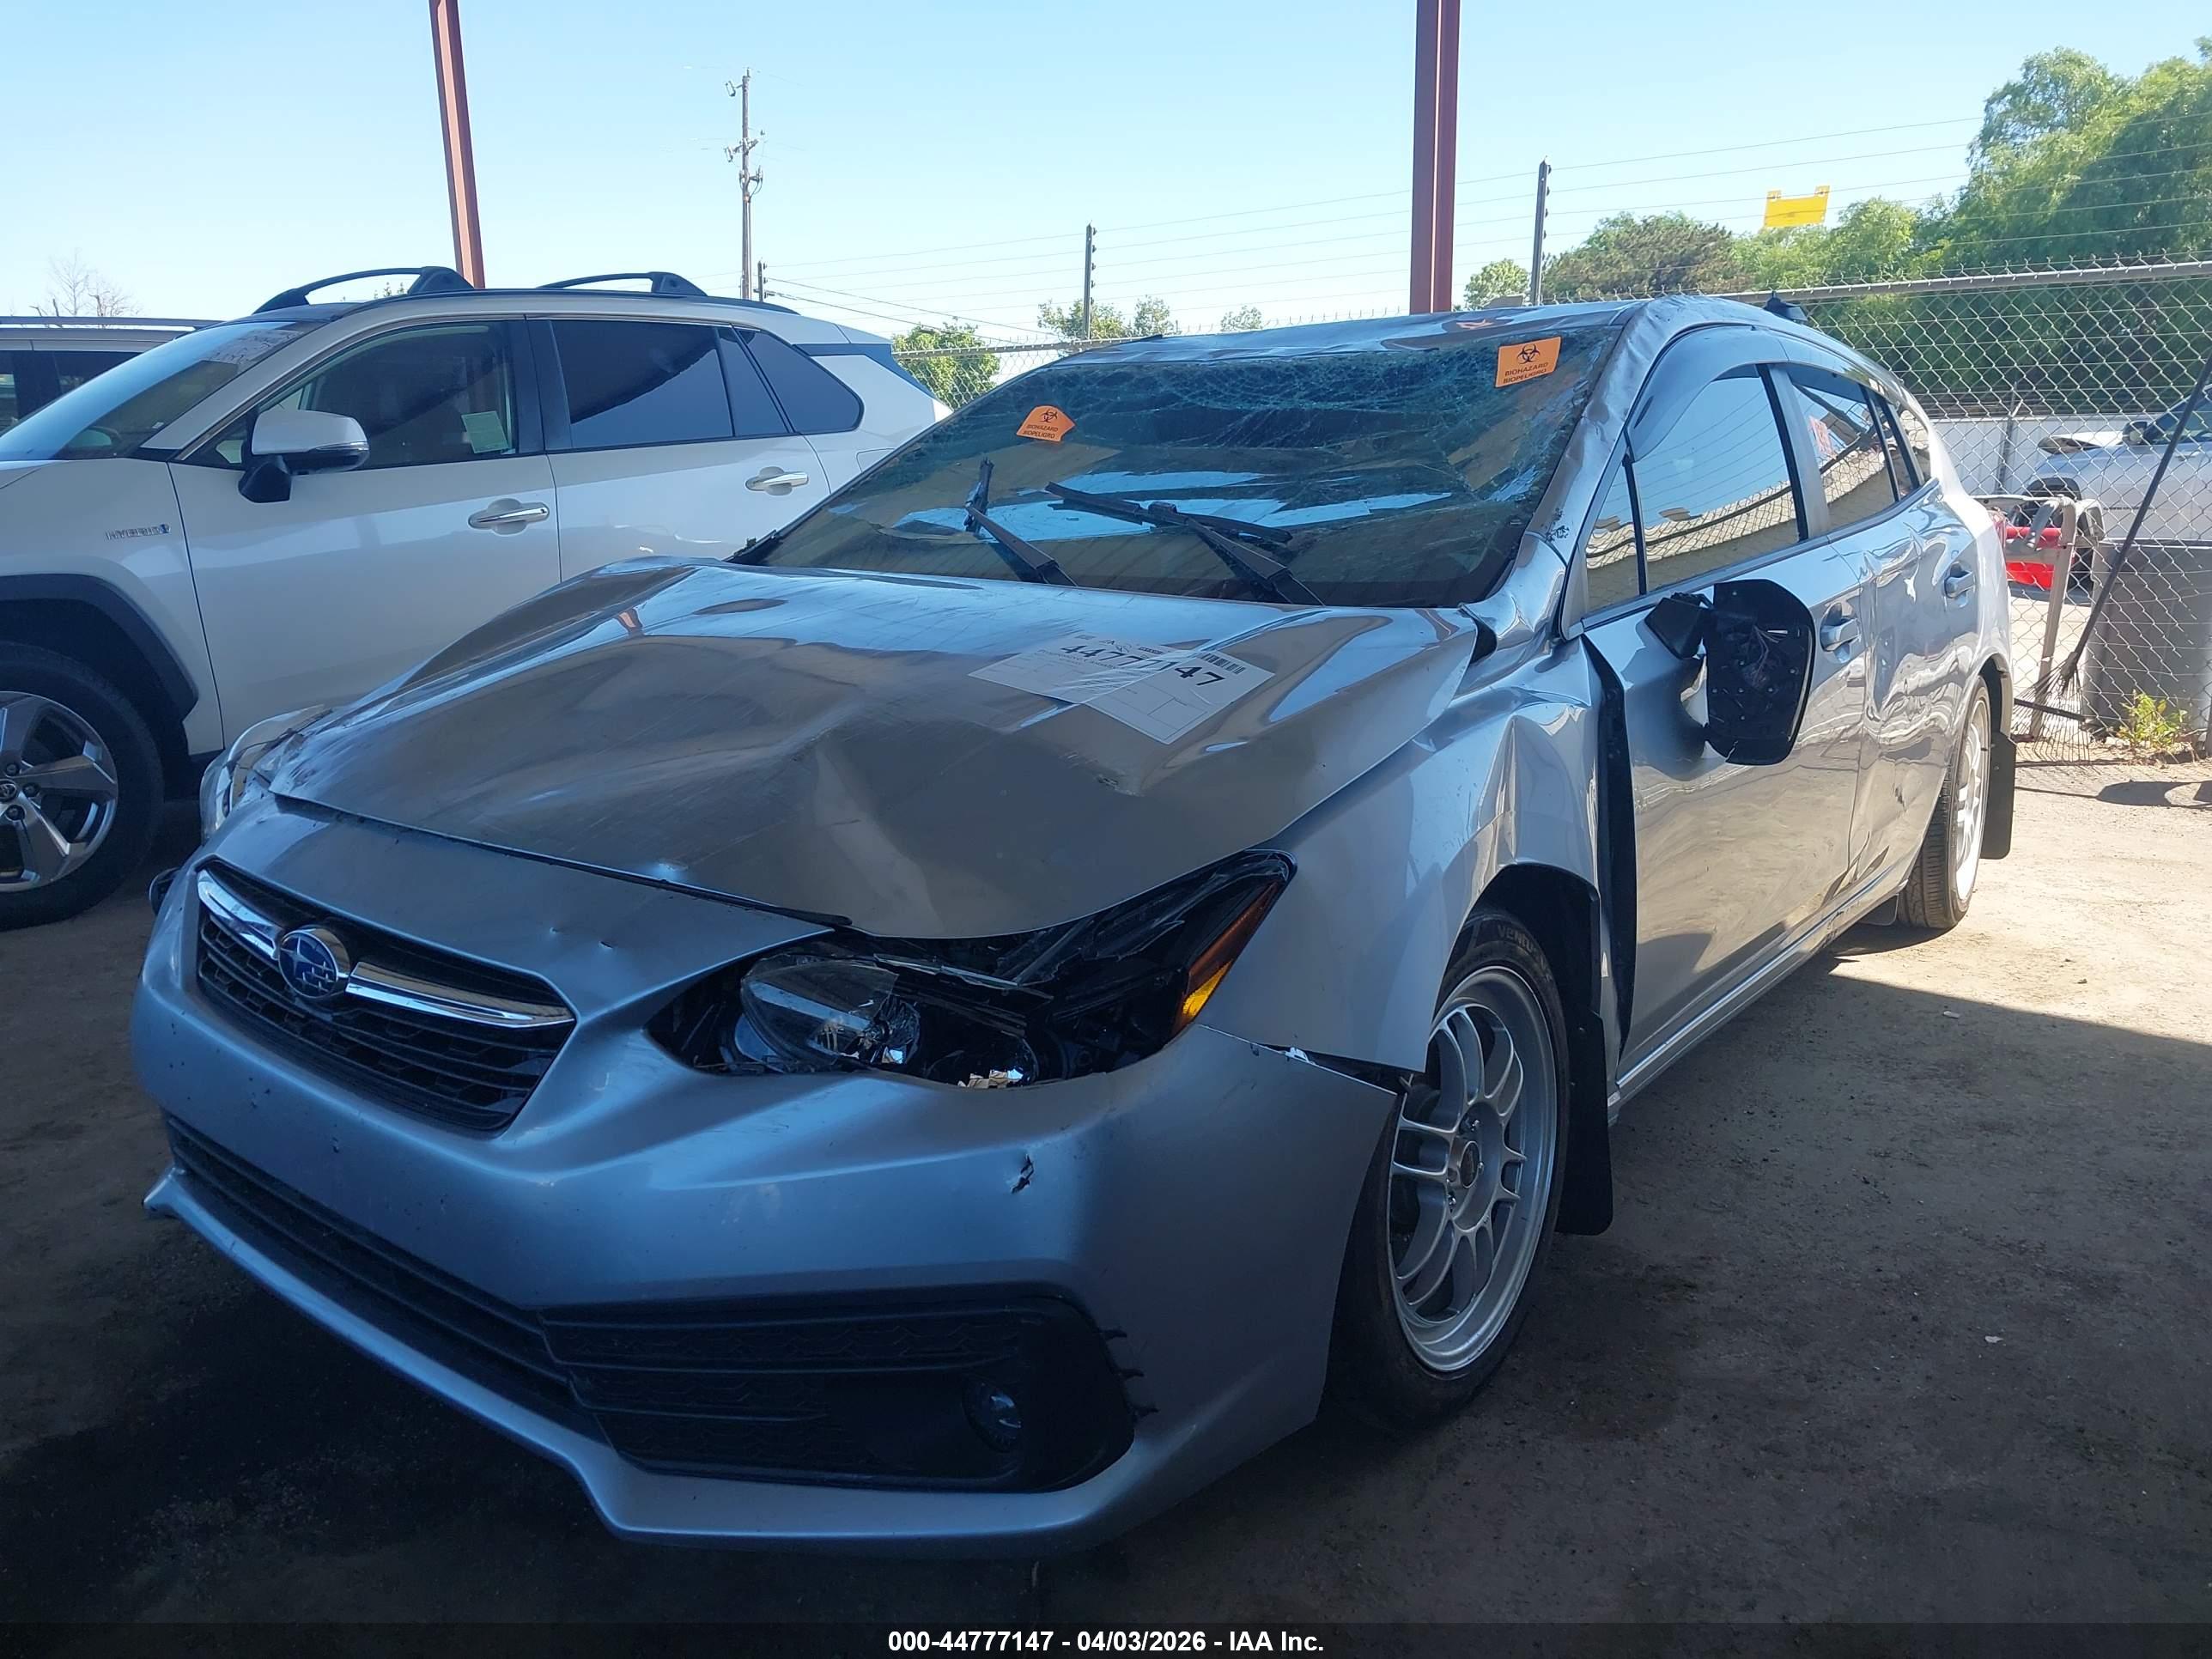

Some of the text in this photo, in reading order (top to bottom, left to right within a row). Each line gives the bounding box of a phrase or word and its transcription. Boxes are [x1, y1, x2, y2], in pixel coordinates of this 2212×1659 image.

[1503, 368, 1547, 384] BIOPELIGRO
[1504, 362, 1549, 376] BIOHAZARD
[1023, 430, 1056, 439] BIOPELIGRO
[1026, 423, 1059, 432] BIOHAZARD
[1060, 644, 1226, 687] 44777147
